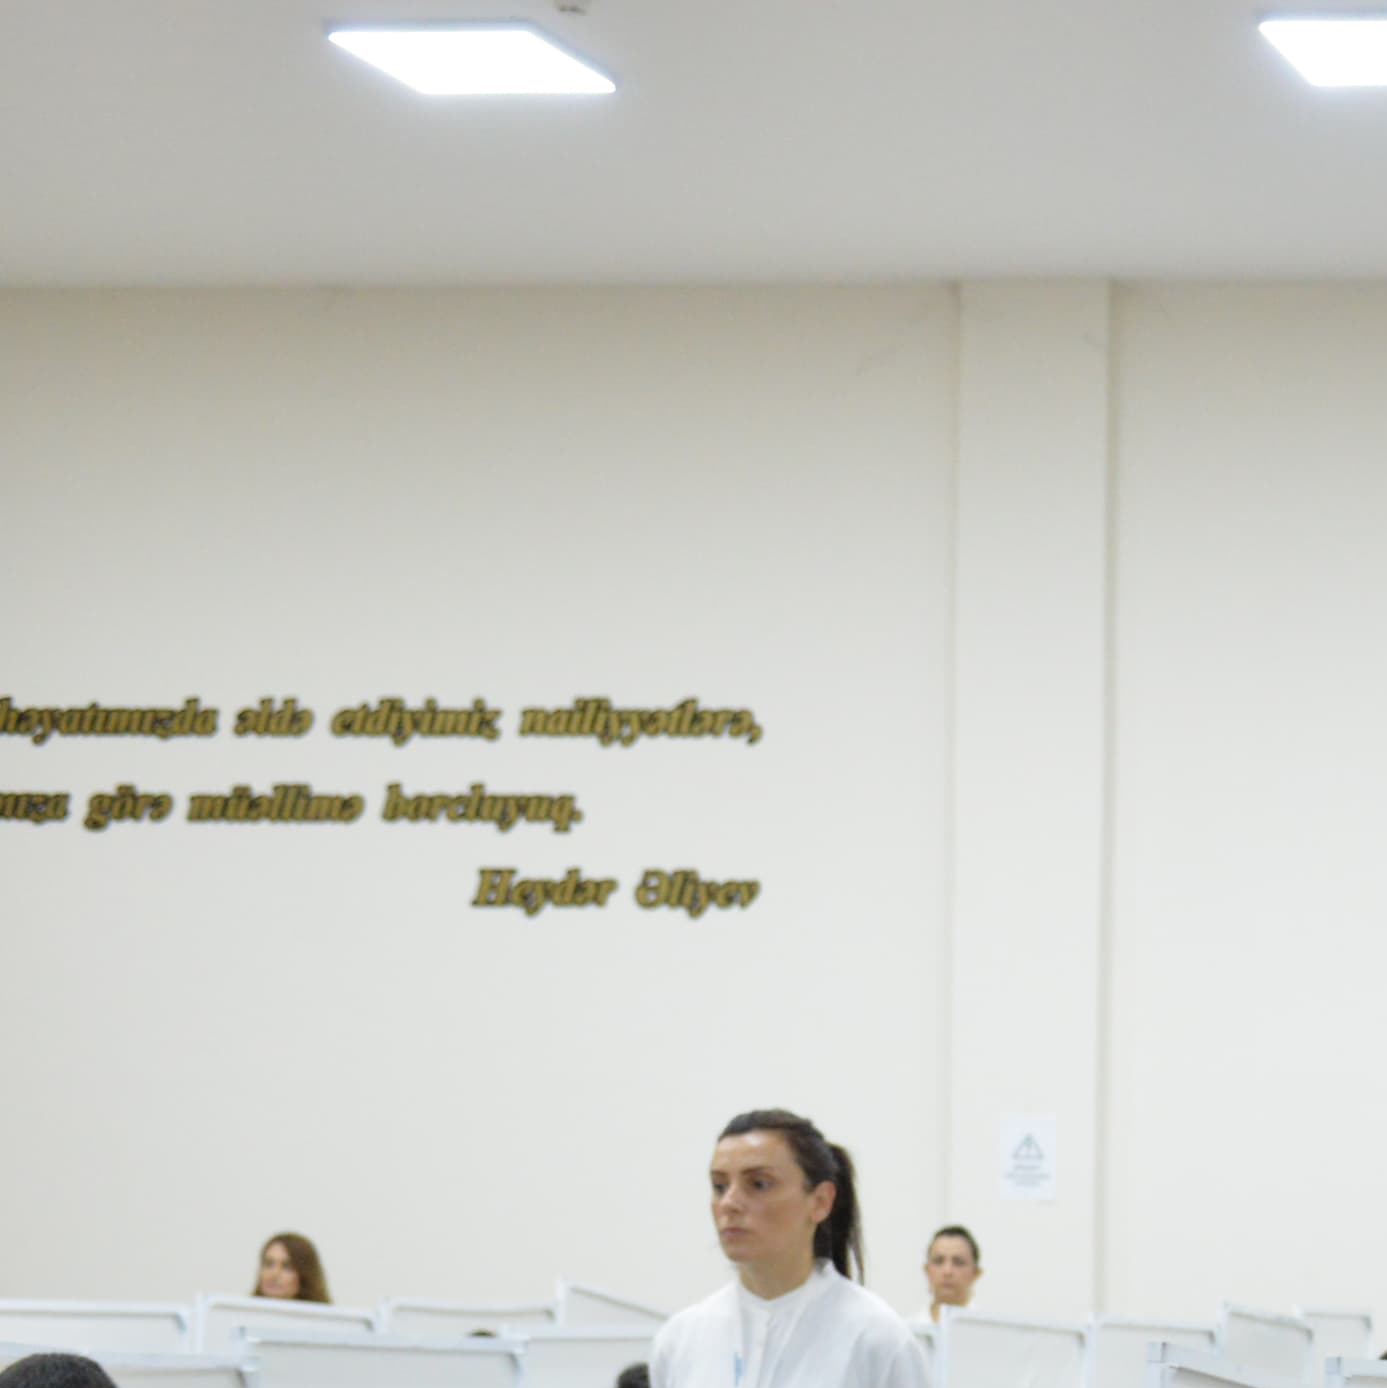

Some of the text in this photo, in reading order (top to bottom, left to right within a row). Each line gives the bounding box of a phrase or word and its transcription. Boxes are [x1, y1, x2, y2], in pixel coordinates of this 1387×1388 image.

[233, 698, 314, 738] əldə
[83, 784, 174, 832] görə
[470, 868, 760, 919] Heydər Əliyev
